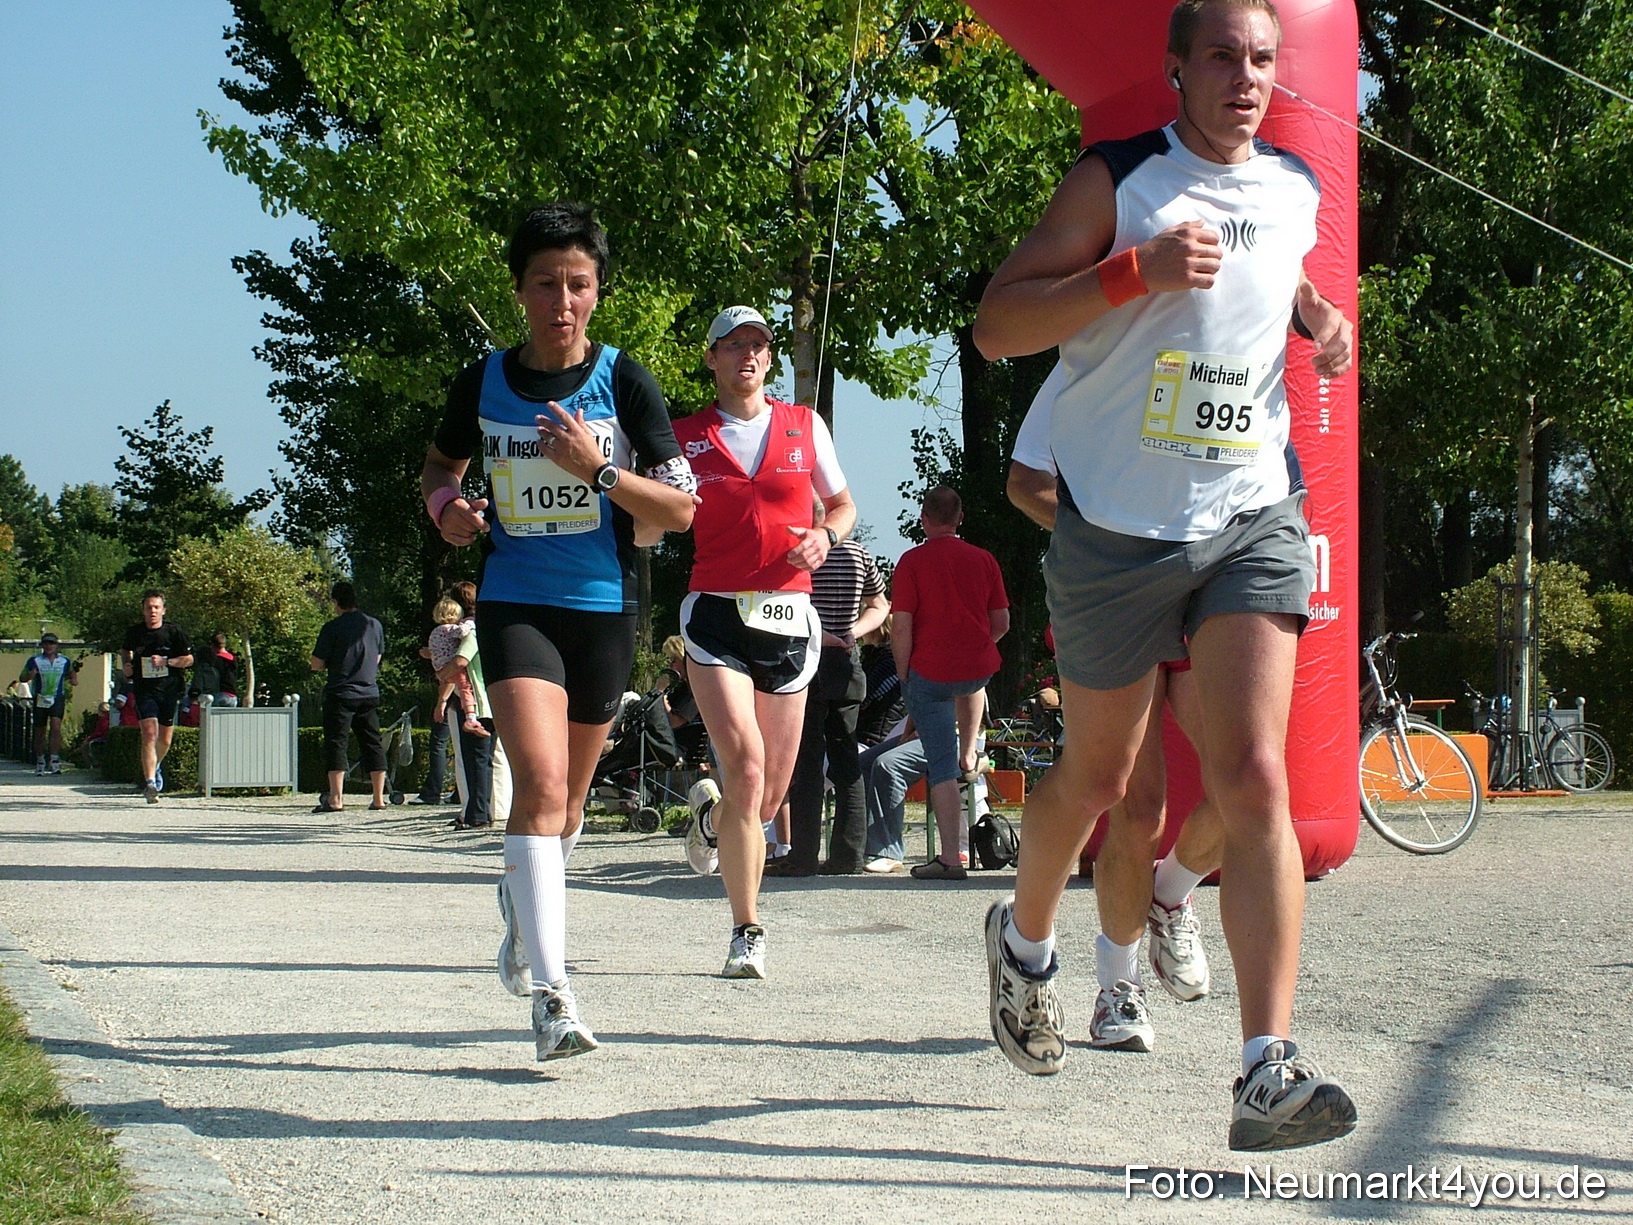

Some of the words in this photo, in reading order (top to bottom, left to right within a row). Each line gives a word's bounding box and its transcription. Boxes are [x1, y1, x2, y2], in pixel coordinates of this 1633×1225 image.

[1190, 361, 1250, 387] Michael
[1153, 387, 1164, 403] C
[1318, 374, 1330, 403] 192
[1195, 400, 1253, 433] 995
[1318, 407, 1330, 434] Seit
[507, 435, 545, 459] Ingo
[1142, 437, 1192, 453] BOCK
[521, 484, 590, 510] 1052
[558, 518, 599, 529] PFLEIDERER
[762, 604, 794, 621] 980
[1308, 600, 1340, 620] sicher
